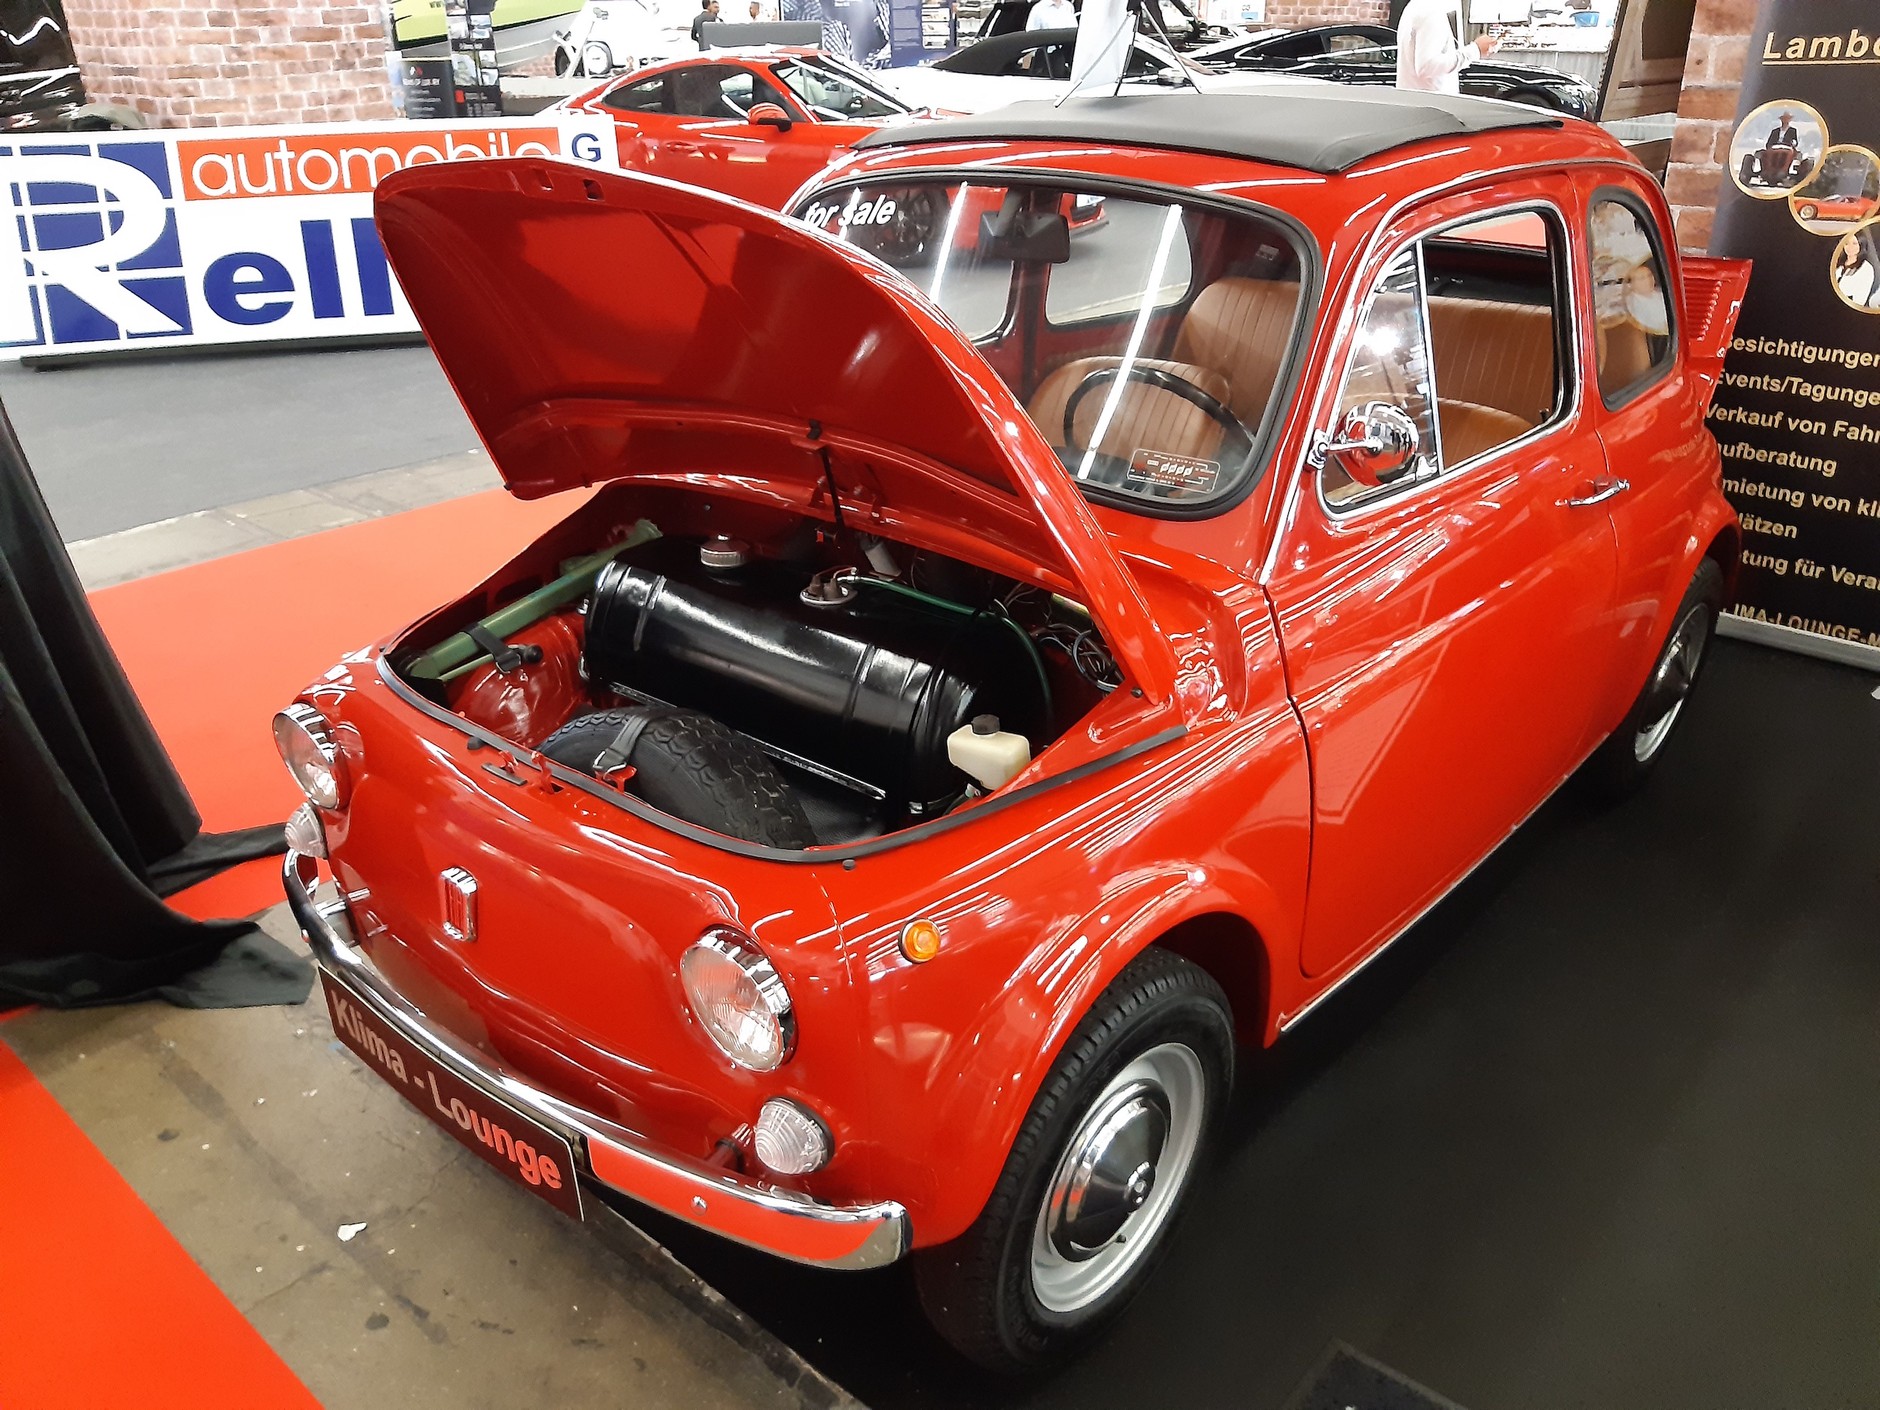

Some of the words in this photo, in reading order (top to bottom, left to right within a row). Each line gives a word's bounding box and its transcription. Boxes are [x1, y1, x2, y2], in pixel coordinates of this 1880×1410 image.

[1728, 335, 1880, 369] esichtigunge
[1788, 417, 1827, 436] von
[1811, 493, 1851, 513] von
[1795, 558, 1826, 579] für
[330, 989, 410, 1083] Klima
[427, 1071, 563, 1190] Lounge
